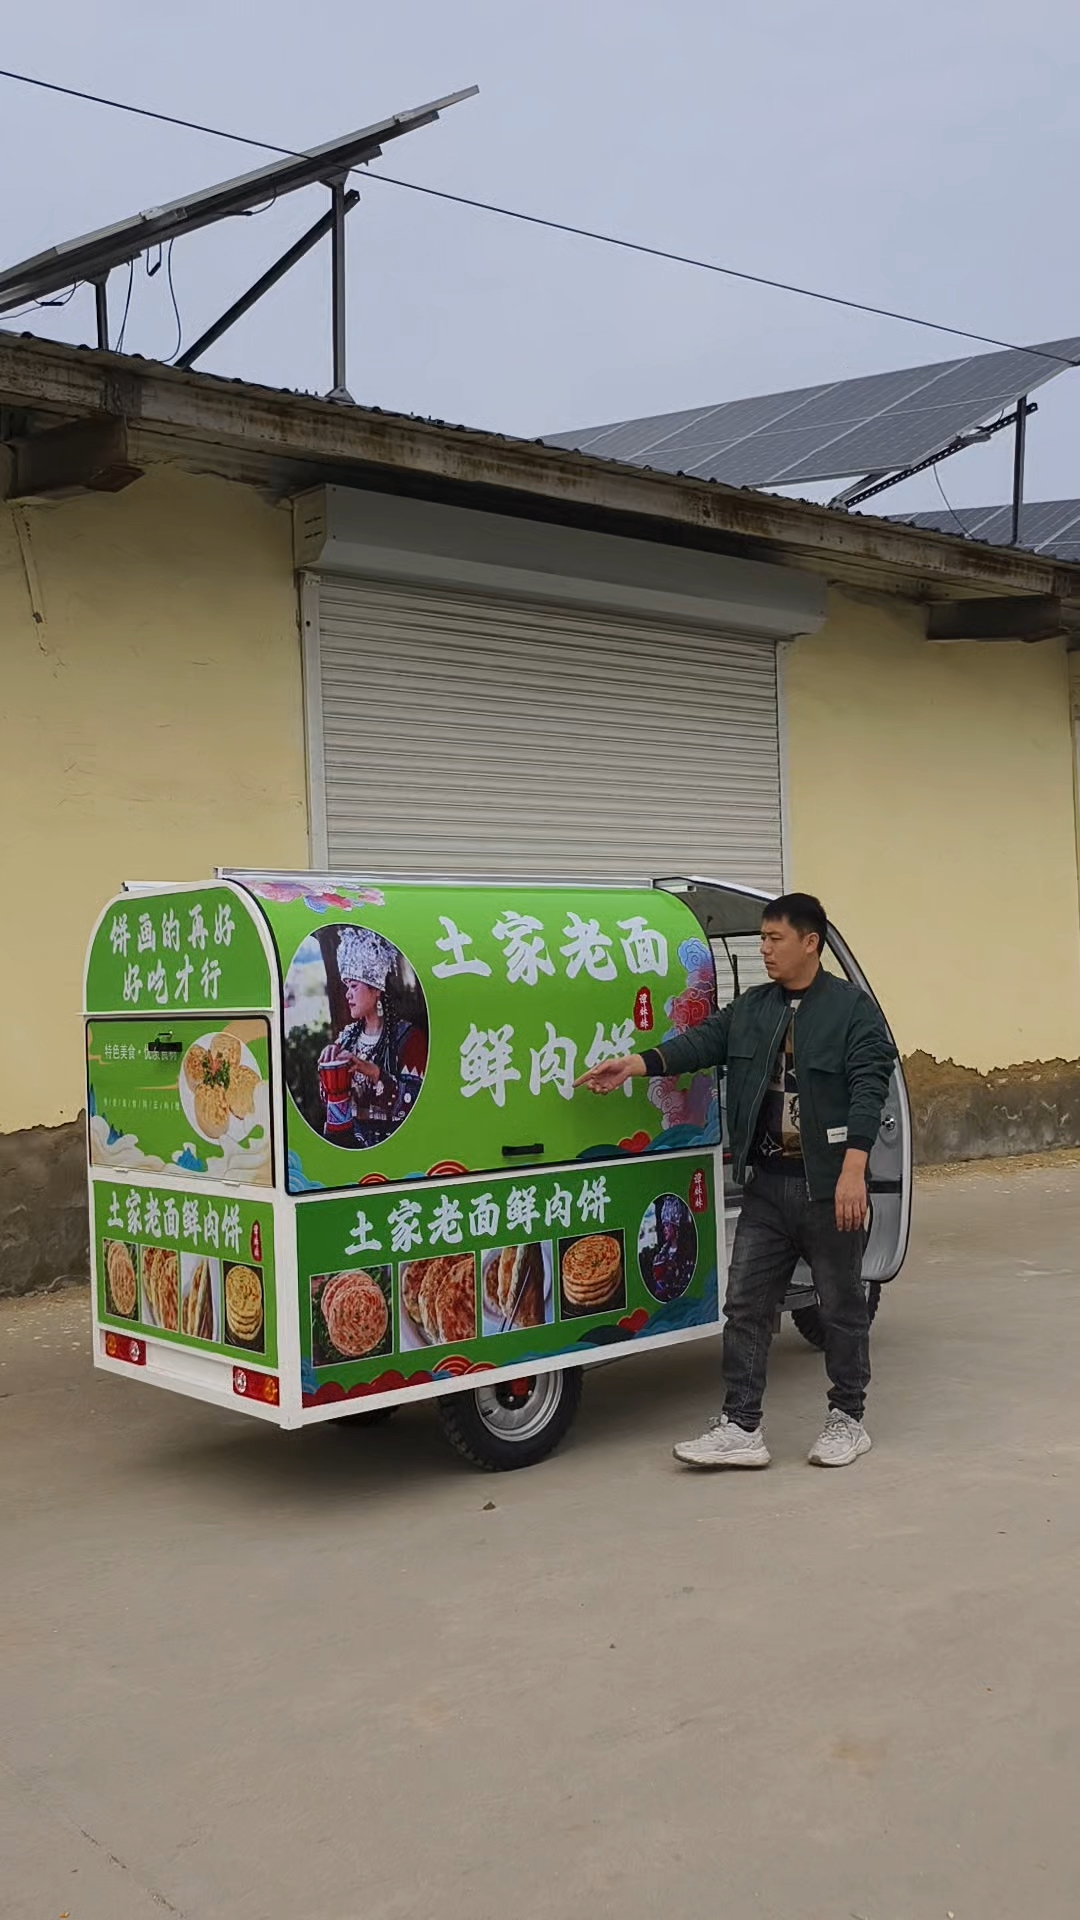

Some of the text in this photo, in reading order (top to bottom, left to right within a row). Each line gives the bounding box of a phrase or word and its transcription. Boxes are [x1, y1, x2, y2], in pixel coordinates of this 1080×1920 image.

[109, 903, 236, 957] 饼画的再好
[431, 910, 668, 986] 土家老面
[122, 954, 222, 1004] 好吃才行
[459, 1017, 637, 1107] 鲜肉饼
[107, 1188, 243, 1254] 土家老面鲜肉饼
[344, 1175, 612, 1256] 土家老面鲜肉饼
